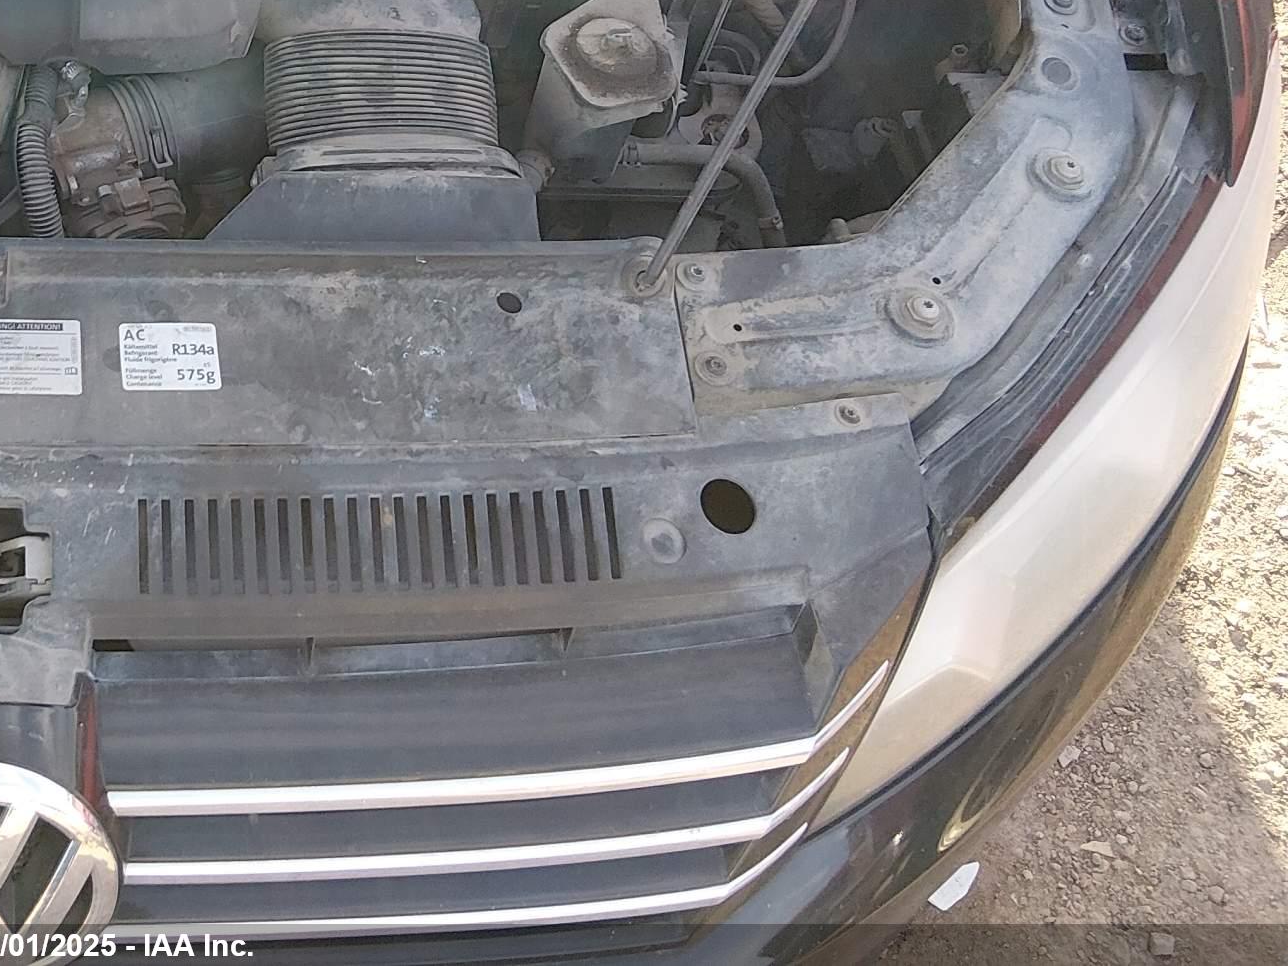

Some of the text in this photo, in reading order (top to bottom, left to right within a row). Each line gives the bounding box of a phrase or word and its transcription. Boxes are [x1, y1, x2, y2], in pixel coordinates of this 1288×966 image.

[17, 322, 60, 331] ATTENTION!
[123, 329, 146, 341] AC
[172, 343, 215, 356] R134a
[177, 368, 216, 384] 575g
